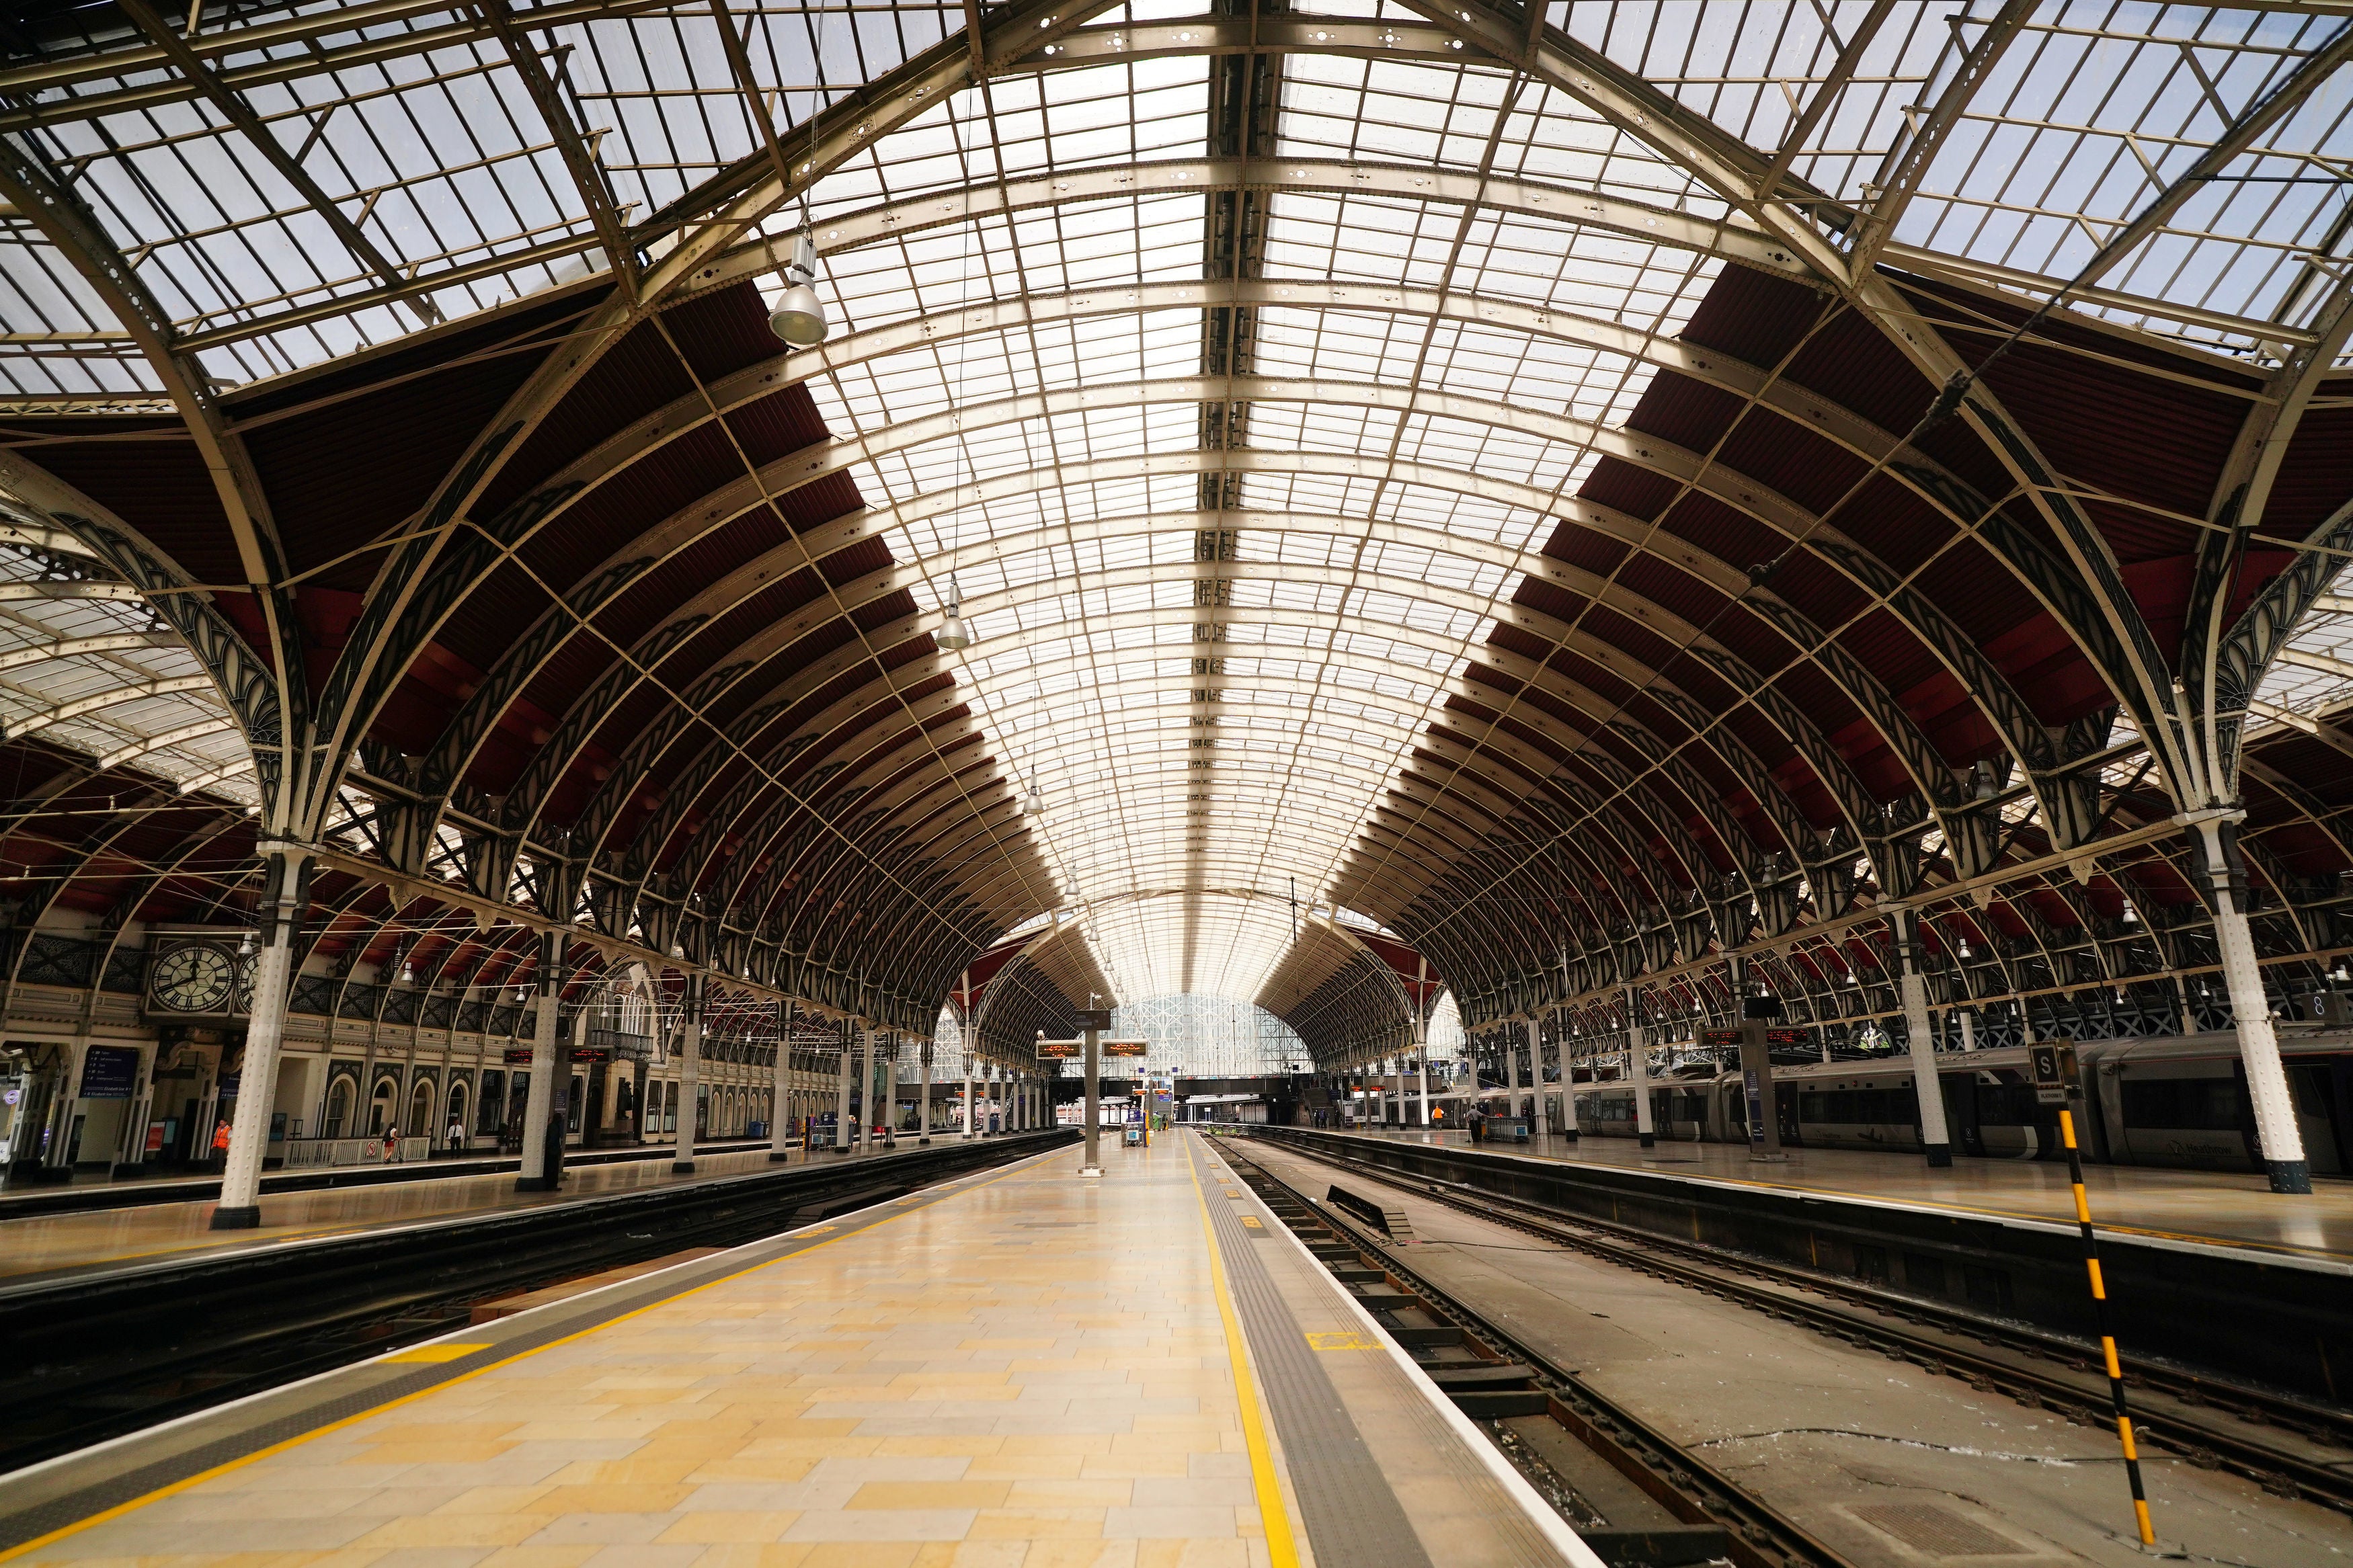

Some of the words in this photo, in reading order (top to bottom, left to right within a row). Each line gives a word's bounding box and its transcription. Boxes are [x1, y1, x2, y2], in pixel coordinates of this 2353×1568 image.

[2313, 996, 2325, 1015] 8
[2040, 1055, 2051, 1074] S
[2186, 1143, 2232, 1155] Heathrow
